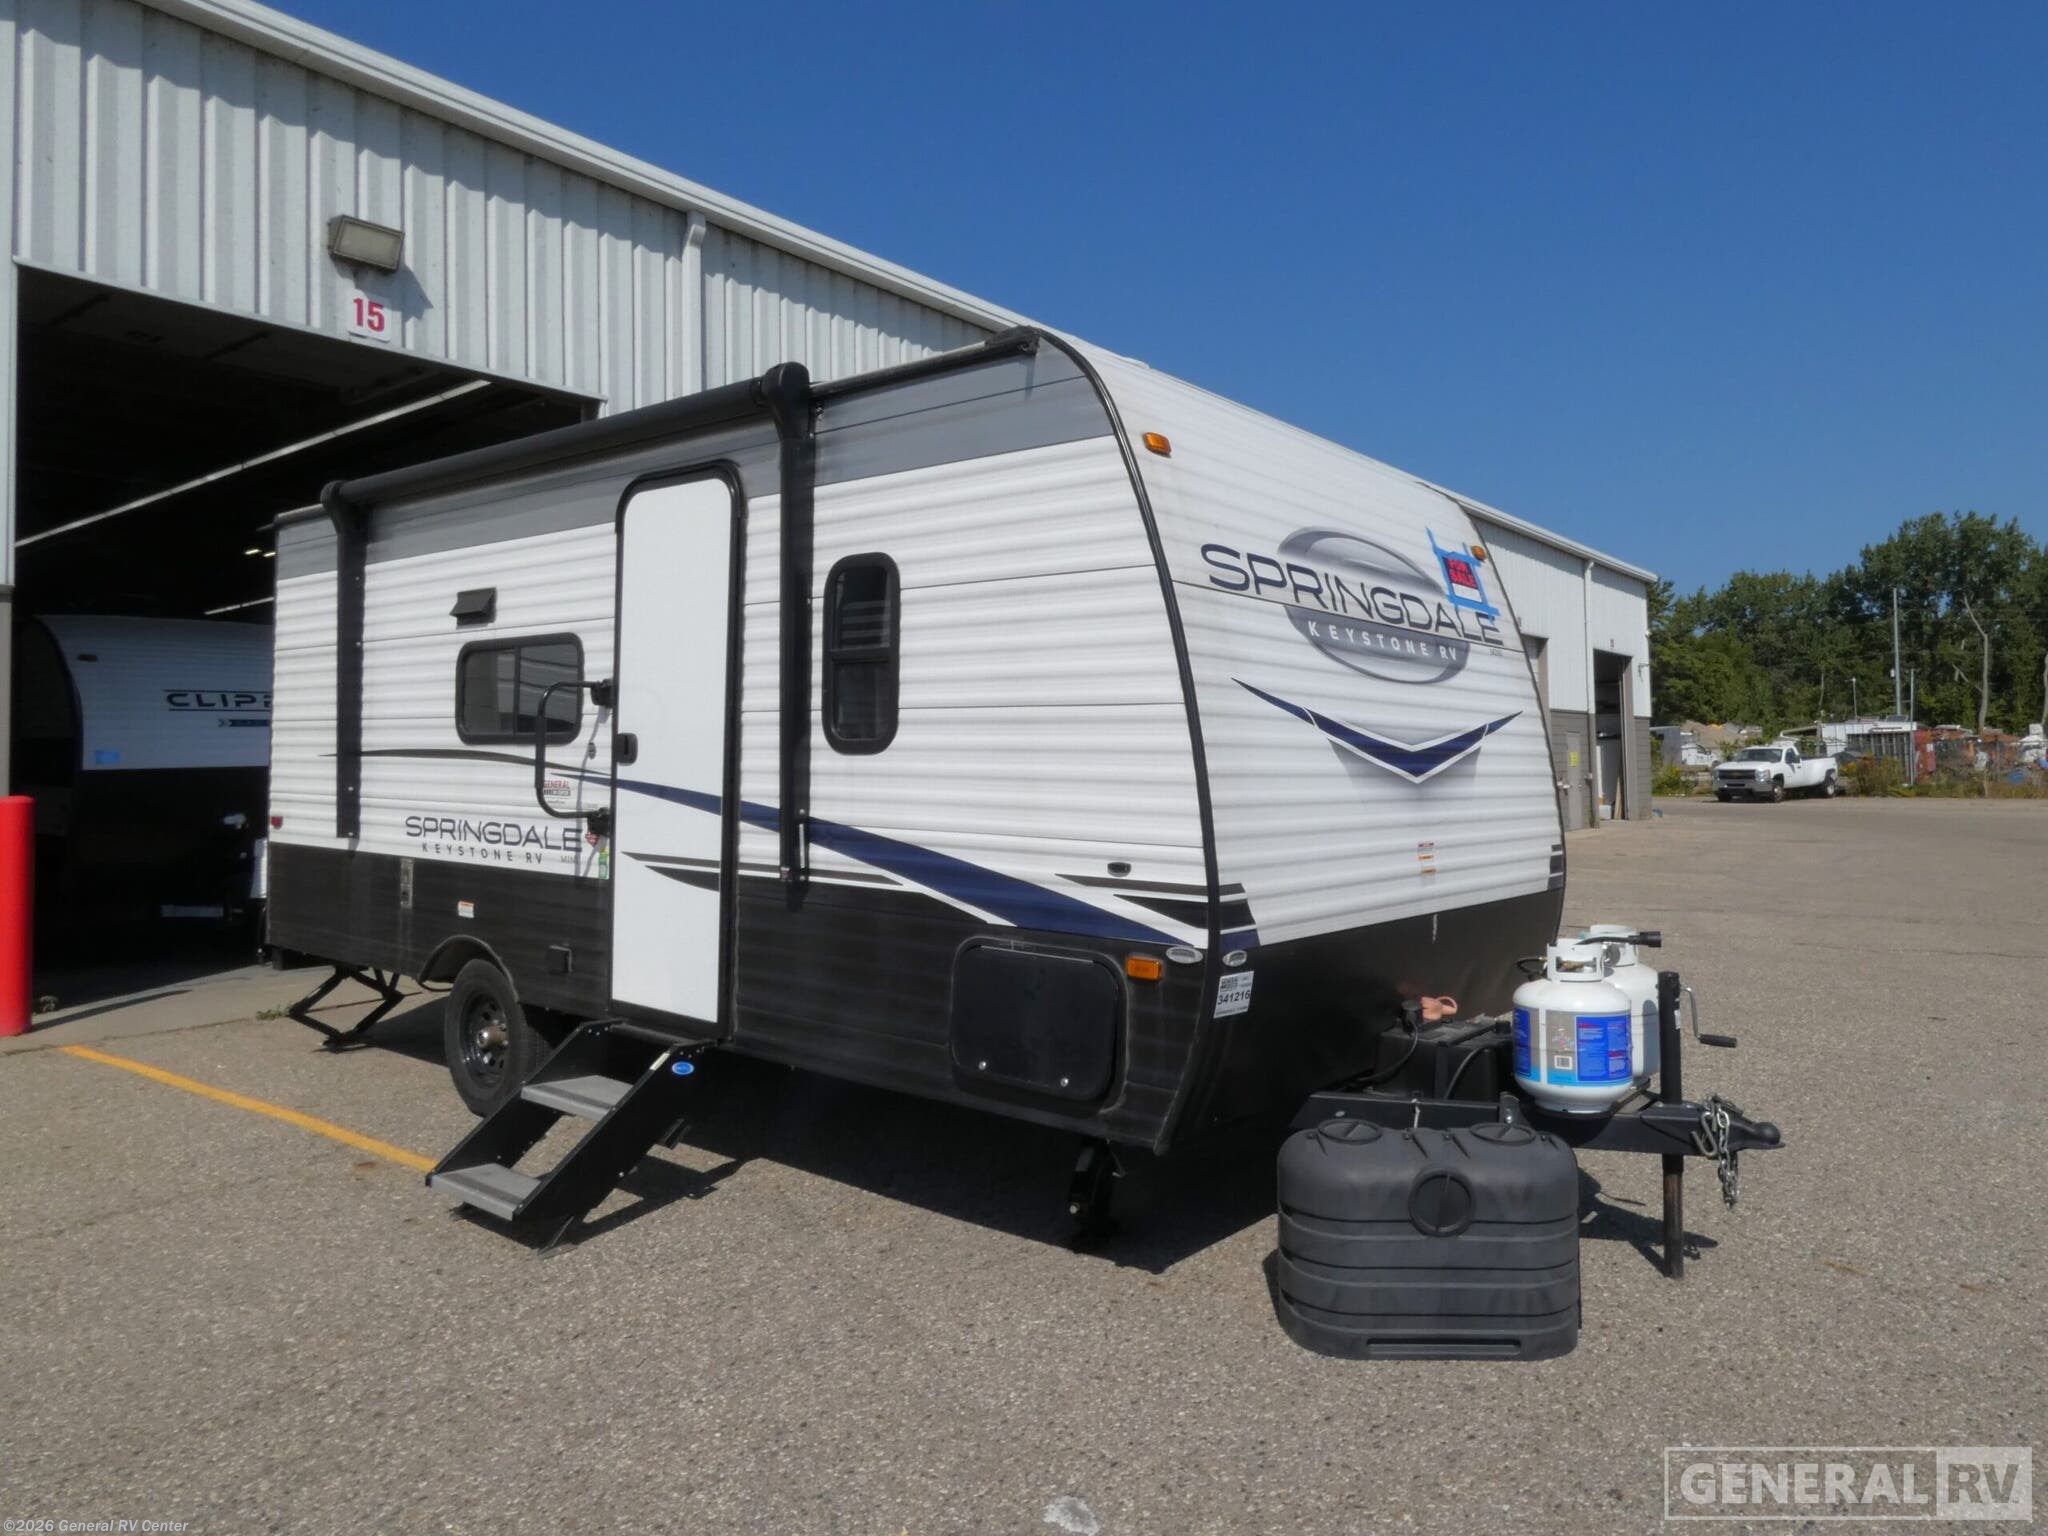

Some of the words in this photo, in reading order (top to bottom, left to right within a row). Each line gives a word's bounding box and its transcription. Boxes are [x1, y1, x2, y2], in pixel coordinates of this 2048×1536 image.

[353, 297, 385, 333] 15
[1200, 543, 1504, 646] SPRINGDALE
[1308, 620, 1430, 656] KEYSTONE
[1439, 644, 1457, 661] RV
[405, 816, 583, 853] SPRINGDALE
[422, 842, 513, 862] KEYSTONE
[526, 852, 543, 864] RV
[1217, 990, 1250, 1005] 341216
